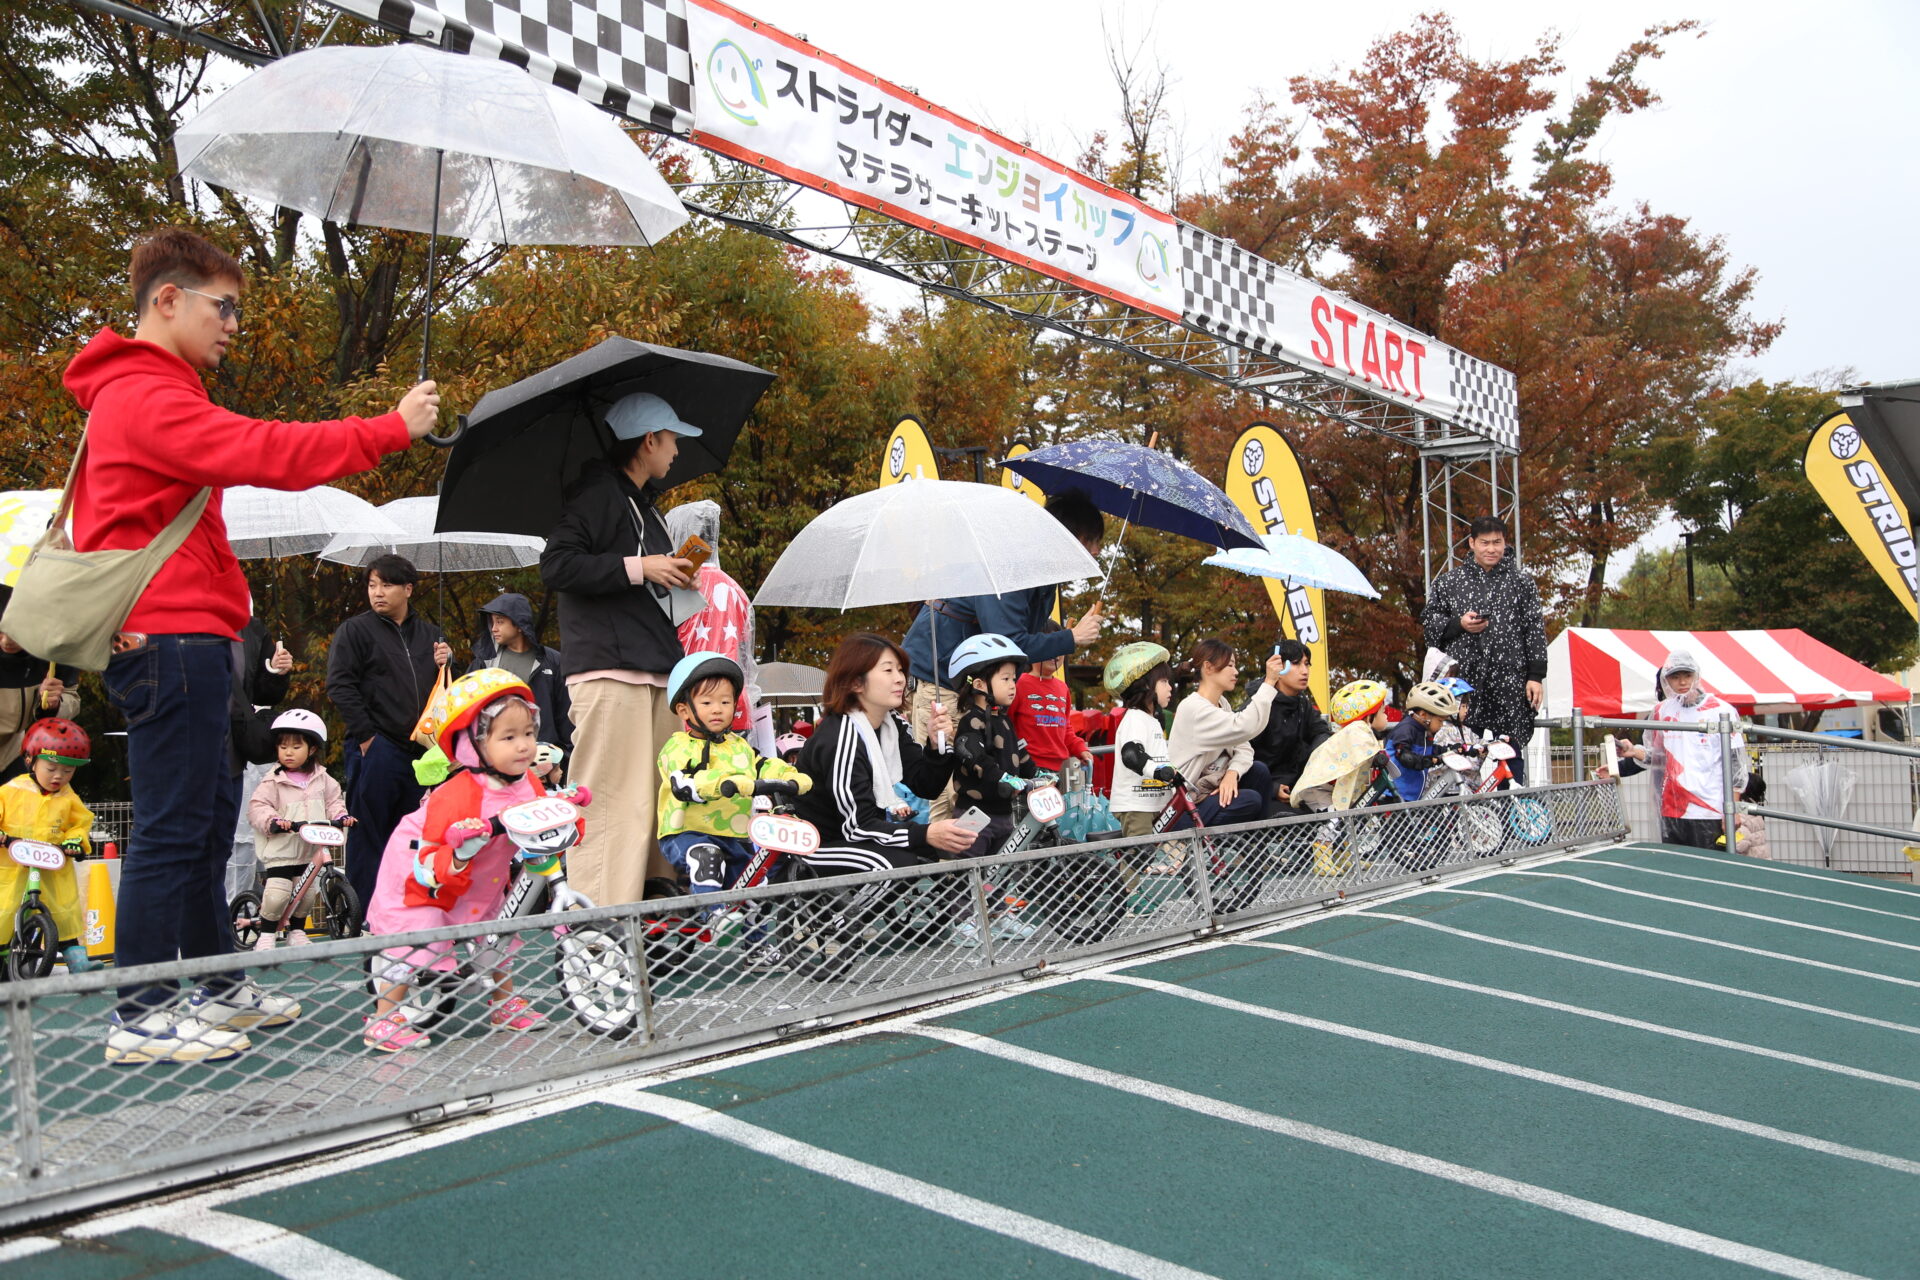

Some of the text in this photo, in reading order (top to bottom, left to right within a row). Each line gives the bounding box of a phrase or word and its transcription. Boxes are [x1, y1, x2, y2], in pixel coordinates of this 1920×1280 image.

[775, 58, 1136, 247] ストライダー エンジョイカップ
[836, 141, 1098, 271] マテラサーキットステージ
[1310, 295, 1426, 402] START
[1843, 460, 1919, 603] STRIDE
[1042, 793, 1062, 812] 014
[532, 803, 572, 822] 016
[319, 830, 342, 842] 022
[778, 828, 813, 847] 015
[33, 850, 60, 865] 023
